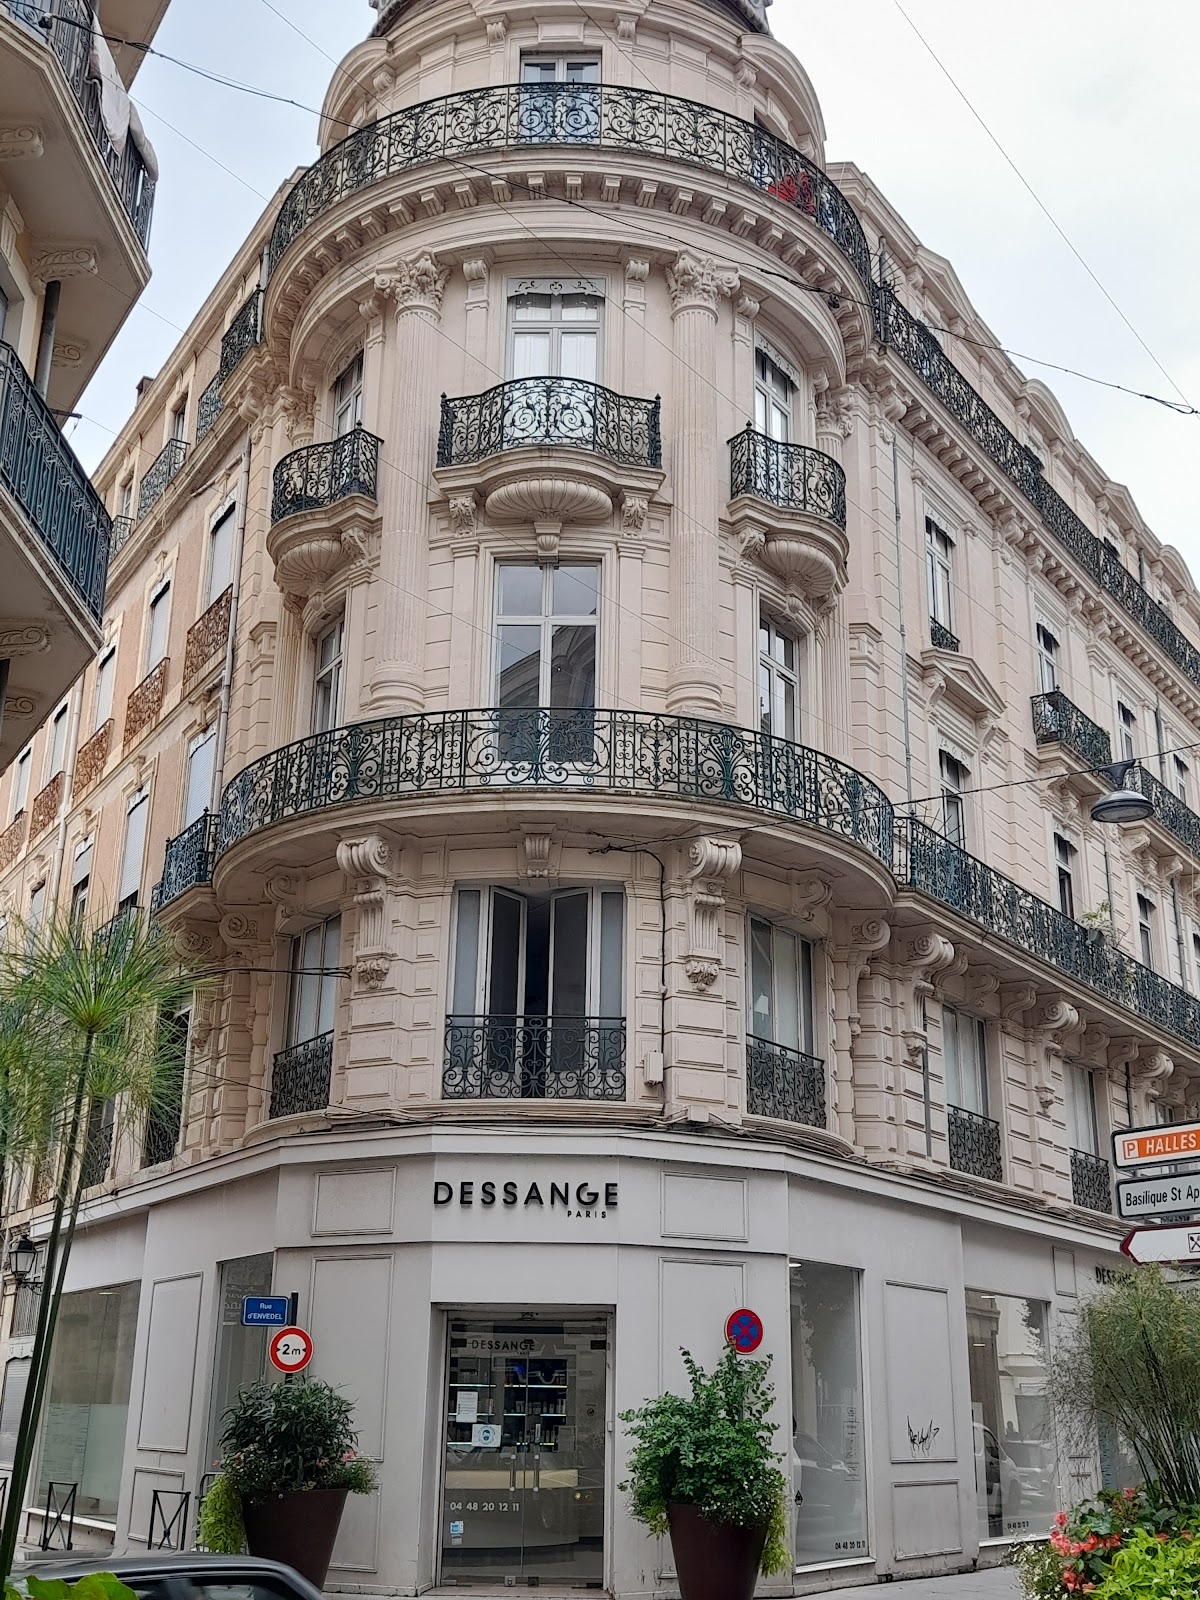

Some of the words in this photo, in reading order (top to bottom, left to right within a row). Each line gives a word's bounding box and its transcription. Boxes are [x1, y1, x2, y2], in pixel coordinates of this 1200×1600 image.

[1146, 1133, 1197, 1155] HALLES
[433, 1181, 618, 1206] DESSANGE
[1126, 1190, 1168, 1208] Basilique
[1171, 1187, 1182, 1202] St
[567, 1210, 607, 1219] PARIS
[259, 1302, 273, 1310] Rue
[247, 1312, 283, 1320] d'ENVEDEL
[472, 1339, 535, 1351] DESSANGE
[450, 1502, 462, 1511] 04
[466, 1502, 478, 1511] 48
[482, 1502, 495, 1511] 20
[499, 1503, 508, 1511] 12
[512, 1503, 519, 1511] 11
